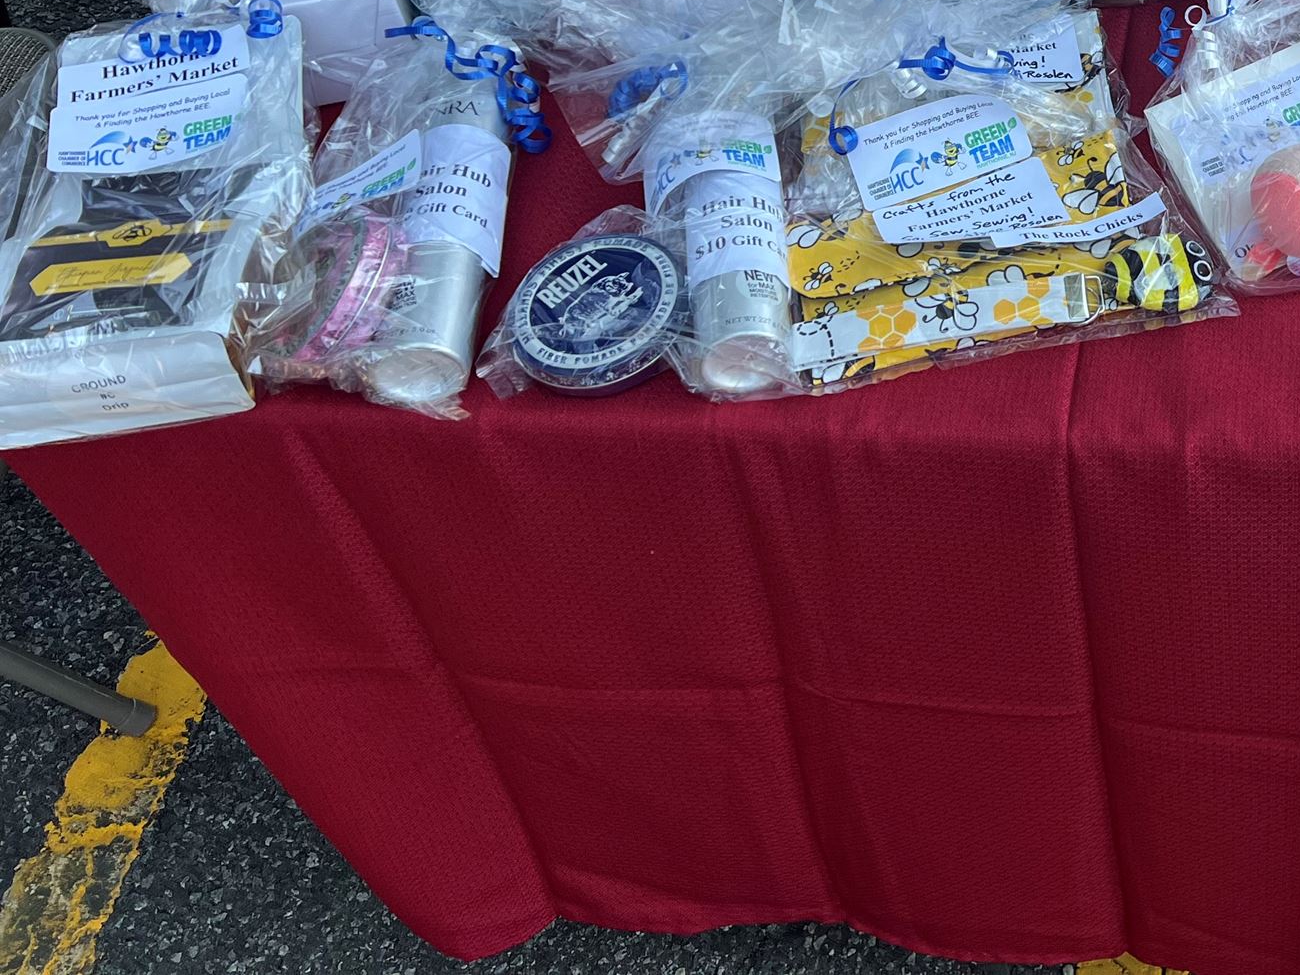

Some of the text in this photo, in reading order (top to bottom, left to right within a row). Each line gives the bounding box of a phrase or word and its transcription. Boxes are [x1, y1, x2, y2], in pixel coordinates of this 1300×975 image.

[71, 57, 238, 103] Farmers' Market
[184, 116, 232, 137] GREEN
[964, 122, 1007, 147] GREEN
[183, 127, 231, 150] TEAM
[968, 136, 1015, 162] TEAM
[87, 148, 124, 166] HCC
[452, 164, 491, 187] Hub
[882, 172, 1015, 220] Crafts from the
[925, 188, 1006, 219] Hawthorne
[452, 205, 488, 227] Card
[720, 215, 772, 231] Salon
[908, 192, 1033, 233] Farmers' Market
[973, 207, 1034, 230] Sewing!
[1009, 214, 1063, 230] Rosolen
[1020, 211, 1143, 241] The Rock Chicks
[732, 236, 762, 247] Gift
[537, 255, 607, 309] REUZEL
[744, 270, 774, 283] NEW
[72, 376, 126, 393] GROUND
